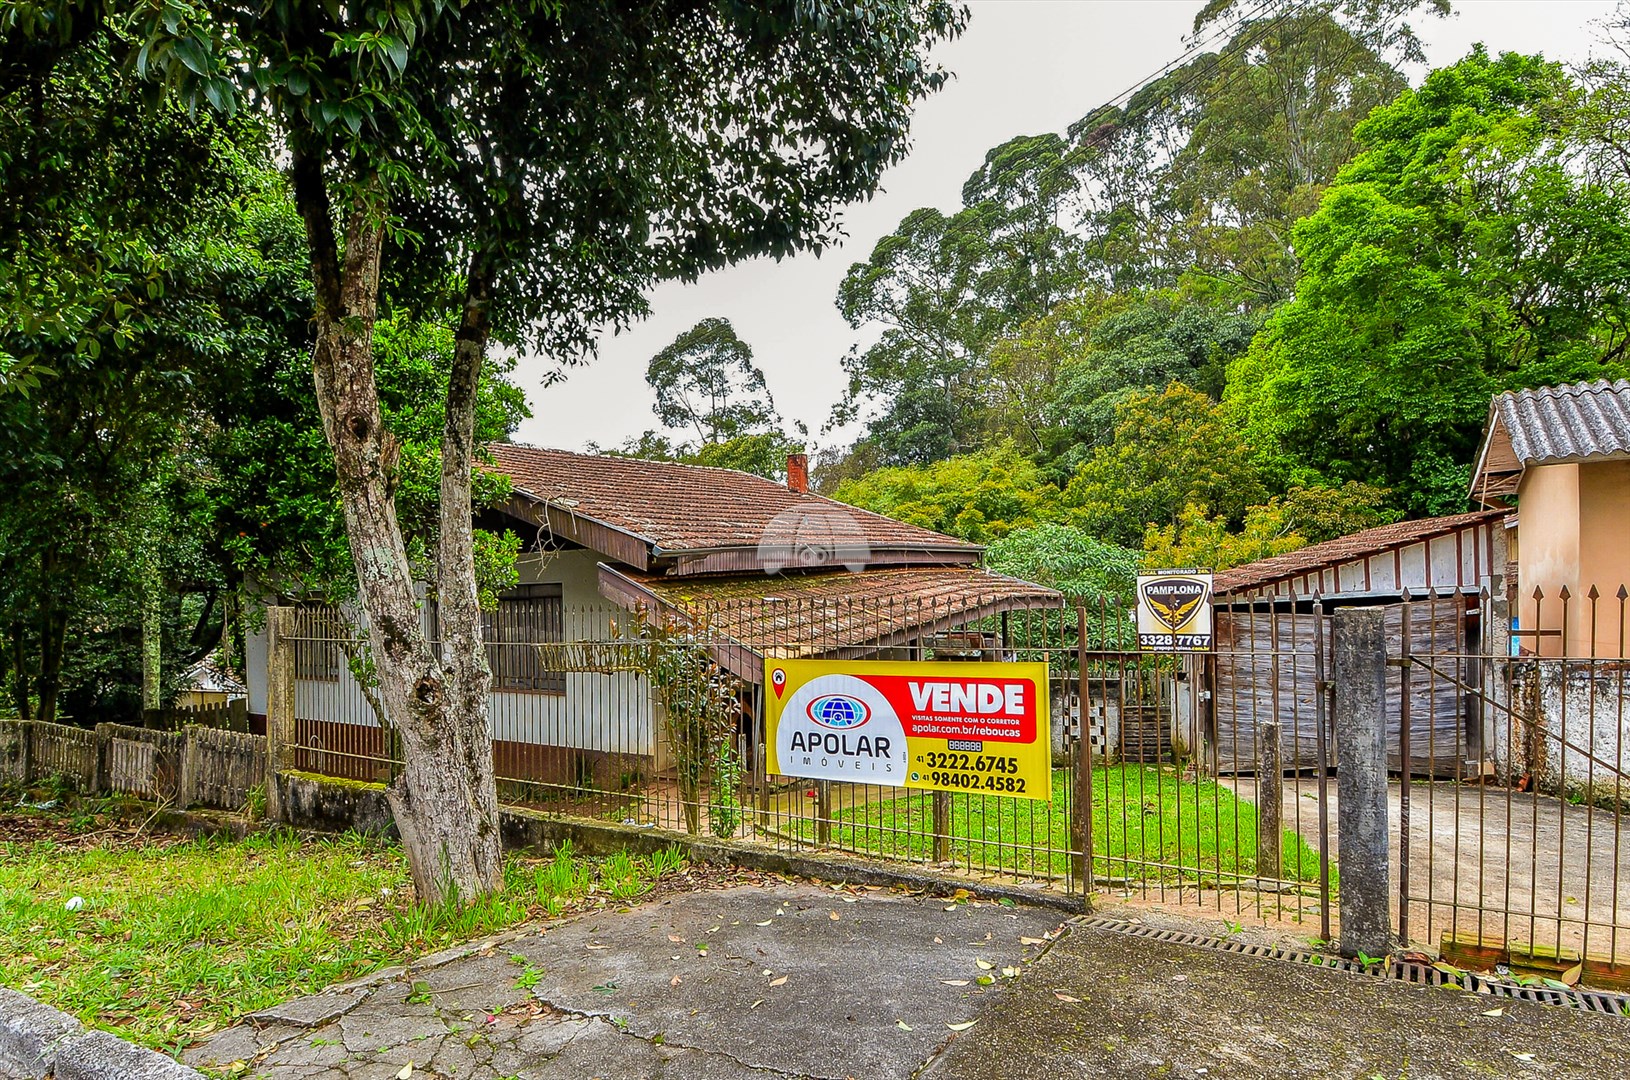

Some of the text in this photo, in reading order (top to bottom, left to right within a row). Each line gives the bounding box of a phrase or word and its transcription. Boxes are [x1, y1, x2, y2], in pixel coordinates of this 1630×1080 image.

[1147, 585, 1202, 595] PAMPLONA
[908, 682, 1025, 715] VENDE
[912, 724, 1021, 738] apolar.com.br/reboucas
[986, 718, 1020, 726] CORRETOR
[790, 731, 891, 759] APOLAR
[790, 756, 892, 772] IMÓVEIS
[916, 755, 925, 763] 41
[926, 752, 1018, 774] 3222.6745
[922, 771, 1026, 793] 41 98402.4582
